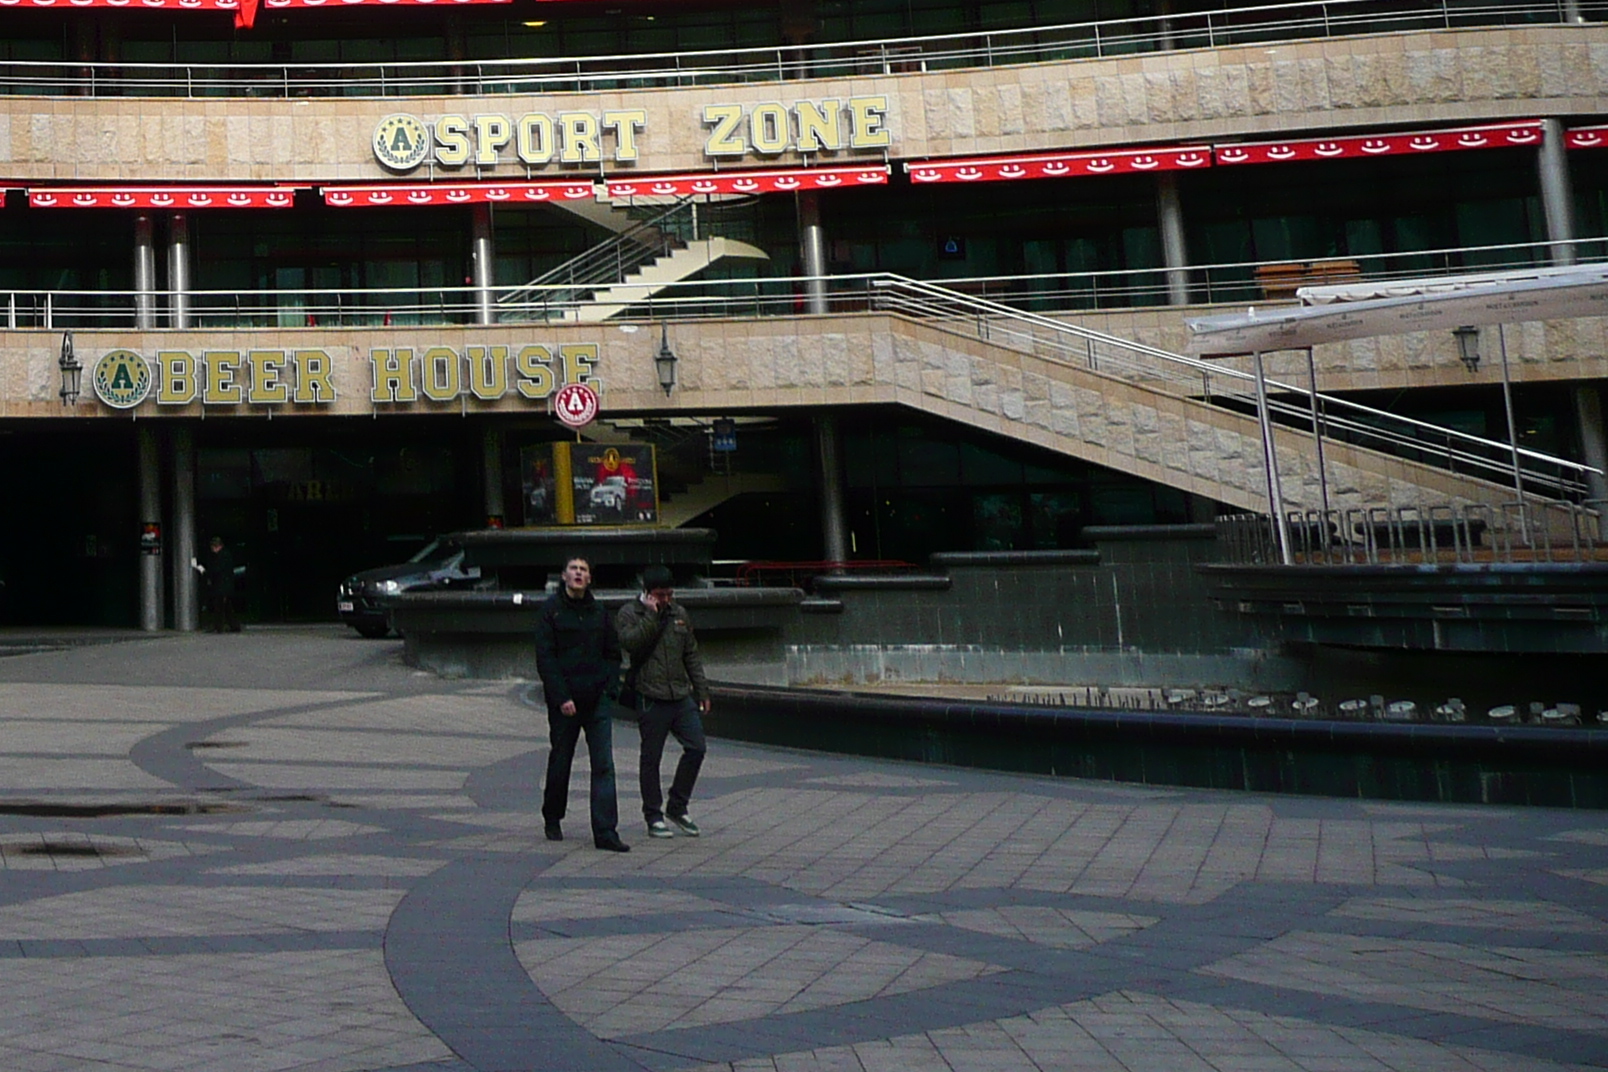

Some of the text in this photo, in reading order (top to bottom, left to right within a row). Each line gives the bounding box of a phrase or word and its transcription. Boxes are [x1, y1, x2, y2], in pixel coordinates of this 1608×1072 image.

[433, 95, 891, 166] SPORT ZONE
[156, 342, 603, 406] BEER HOUSE
